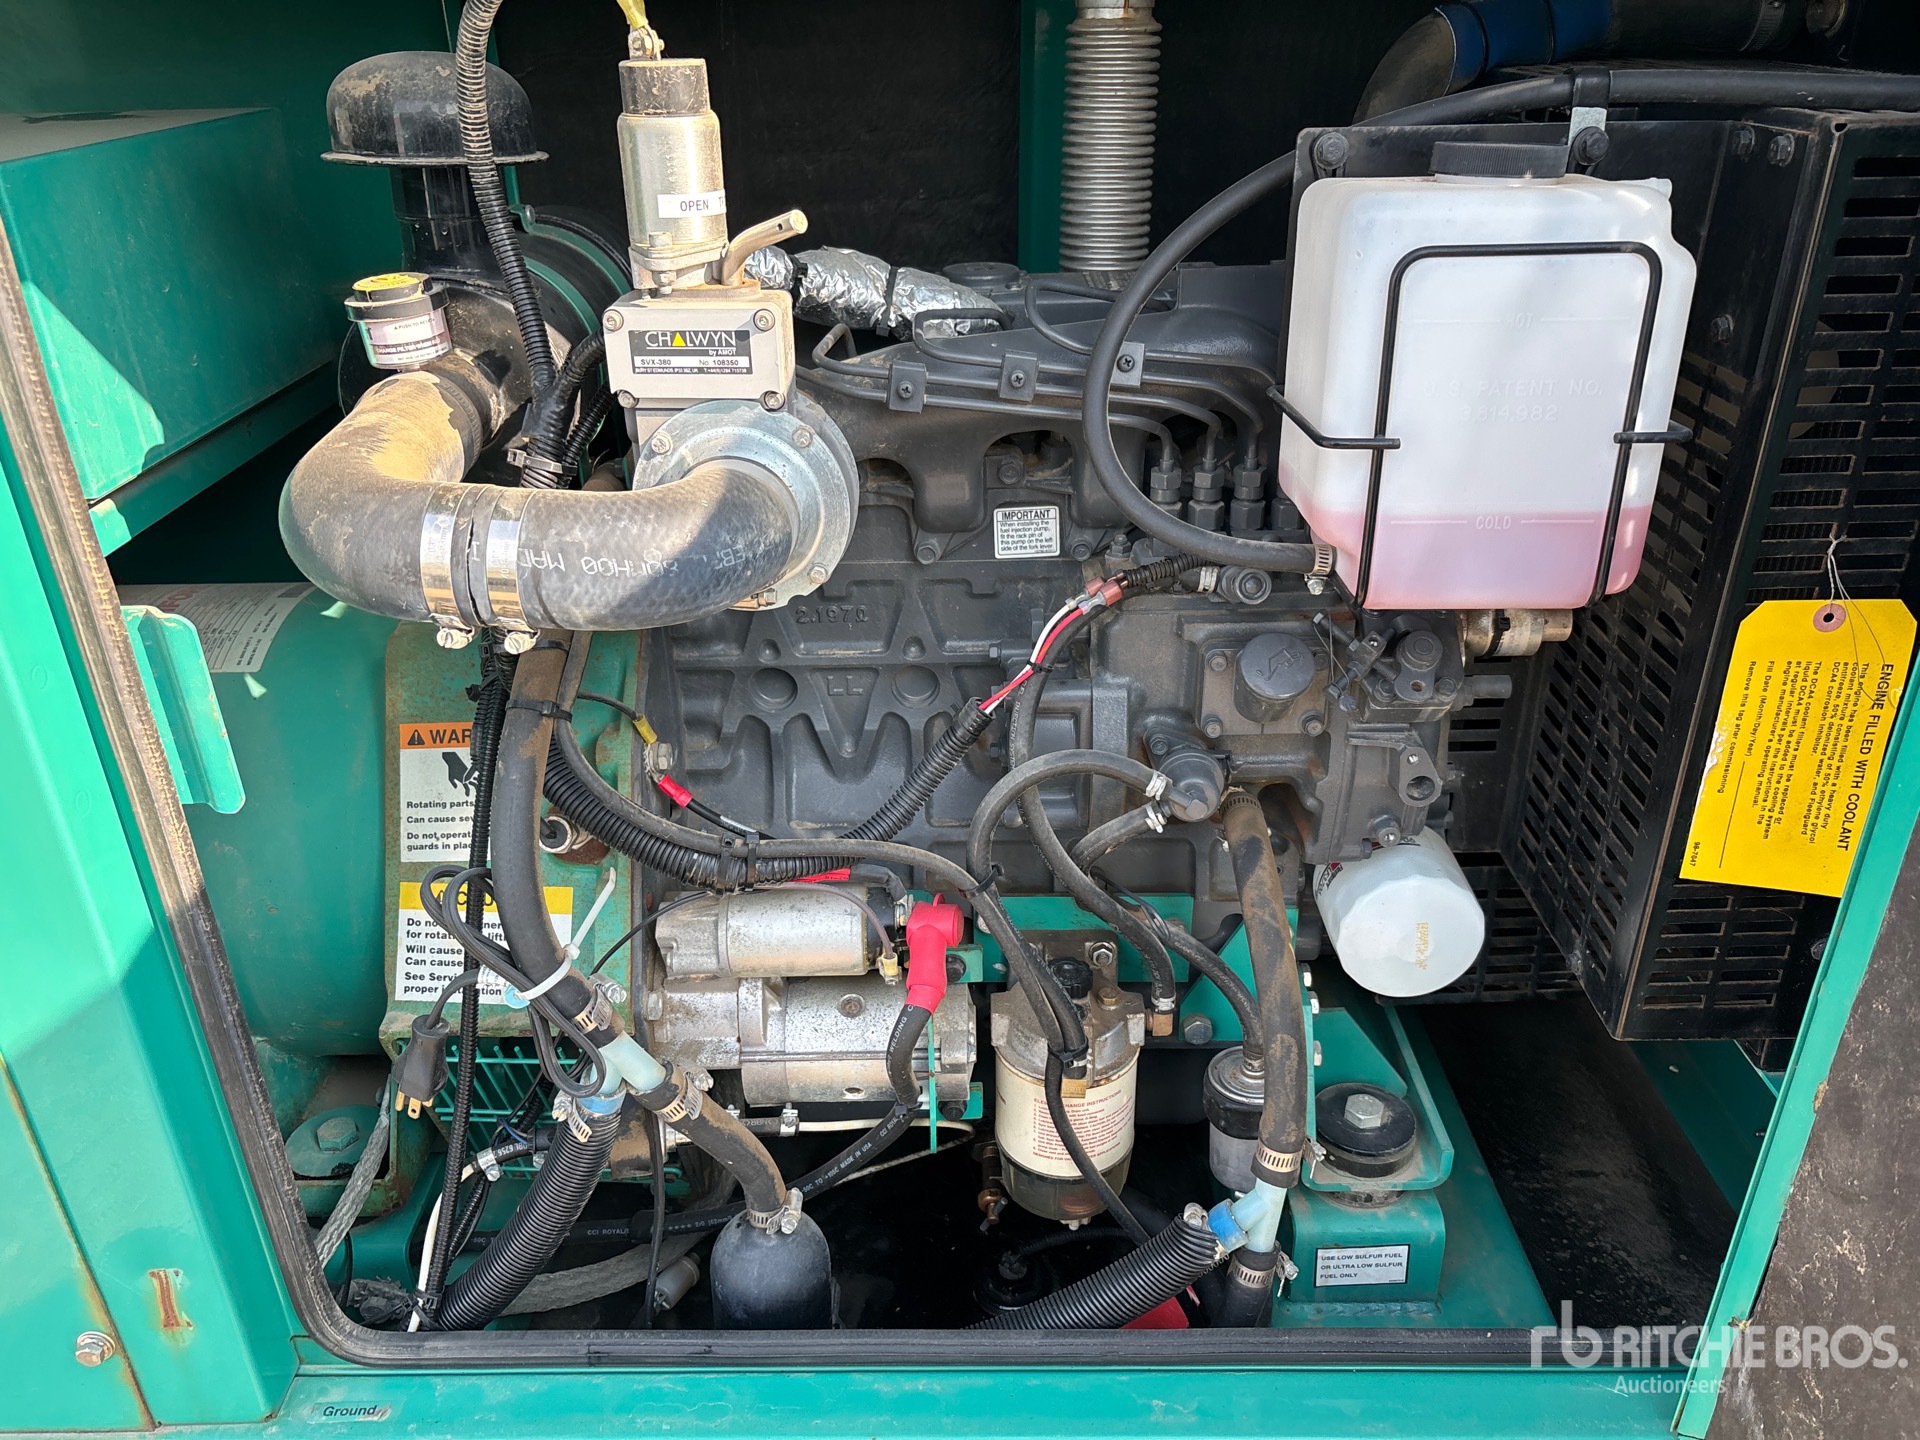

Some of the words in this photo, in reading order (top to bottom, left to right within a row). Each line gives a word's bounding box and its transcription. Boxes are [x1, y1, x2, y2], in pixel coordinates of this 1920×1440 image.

[680, 200, 709, 211] OPEN
[645, 331, 736, 346] CHALWYN
[1477, 379, 1558, 395] PATENT
[1569, 379, 1602, 395] NO.
[1002, 510, 1050, 520] IMPORTANT
[1476, 515, 1512, 530] COLD
[1766, 660, 1774, 672] Fill
[1782, 660, 1792, 686] engine
[1795, 660, 1801, 668] at
[1801, 661, 1812, 682] liquid
[1812, 661, 1822, 675] The
[1829, 661, 1840, 682] DCA4
[1859, 662, 1869, 678] This
[1743, 661, 1756, 690] Remove
[1762, 675, 1771, 692] Date
[1789, 671, 1799, 697] regular
[1834, 661, 1848, 700] antifreeze,
[1847, 661, 1859, 690] coolant
[1796, 685, 1806, 705] DCA4
[1807, 678, 1817, 698] DCA4
[1852, 681, 1863, 707] engine
[1871, 663, 1893, 709] ENGINE
[1740, 693, 1748, 707] this
[1820, 685, 1833, 720] corrosion
[1838, 693, 1850, 720] mixture
[1735, 709, 1744, 720] tag
[1767, 689, 1785, 742] manufacturer's
[1780, 700, 1793, 731] intervals
[1791, 709, 1800, 726] must
[1799, 701, 1810, 728] coolant
[1829, 703, 1839, 719] 50%
[1847, 709, 1857, 722] has
[1732, 723, 1740, 739] after
[1745, 695, 1766, 756] (Month/Day/Year)
[1787, 729, 1795, 737] be
[1843, 725, 1852, 742] been
[1859, 714, 1880, 754] FILLED
[1793, 731, 1804, 751] filters
[1811, 723, 1824, 755] inhibitor.
[1820, 721, 1833, 755] deionized
[1827, 723, 1842, 760] consisting
[1772, 747, 1780, 758] the
[1781, 740, 1791, 761] added
[1837, 744, 1847, 762] filled
[1717, 742, 1735, 793] commissioning
[1757, 745, 1771, 777] operating
[1788, 754, 1797, 771] must
[1813, 758, 1824, 779] water,
[1762, 761, 1776, 802] instructions
[1775, 773, 1783, 784] the
[1785, 773, 1792, 782] be
[1821, 772, 1830, 787] 50%
[1833, 765, 1841, 779] with
[1850, 759, 1868, 788] WITH
[1752, 780, 1762, 805] manual.
[1810, 781, 1818, 795] and
[407, 801, 447, 809] Rotating
[1767, 786, 1779, 812] cooling
[1777, 784, 1789, 814] replaced
[1814, 789, 1825, 819] ethylene
[1824, 789, 1836, 810] heavy
[407, 816, 425, 824] Can
[1756, 814, 1764, 824] the
[1801, 798, 1815, 835] Fleetguard
[1820, 813, 1830, 828] duty
[1837, 793, 1859, 850] COOLANT
[407, 832, 419, 840] Do
[440, 832, 471, 840] operat
[1763, 815, 1773, 839] system
[1809, 822, 1818, 843] glycol
[407, 842, 439, 851] guards
[442, 842, 450, 850] in
[453, 841, 472, 850] plac
[407, 918, 421, 927] Do
[406, 930, 421, 939] for
[406, 945, 426, 954] Will
[429, 947, 462, 955] cause
[405, 957, 427, 966] Can
[430, 958, 464, 967] cause
[405, 972, 424, 981] See
[403, 985, 438, 995] proper
[889, 1016, 908, 1053] WELDING
[815, 1178, 823, 1186] TO
[840, 1155, 854, 1169] MADE
[855, 1150, 861, 1158] IN
[861, 1142, 873, 1152] USA
[323, 1405, 377, 1417] Ground
